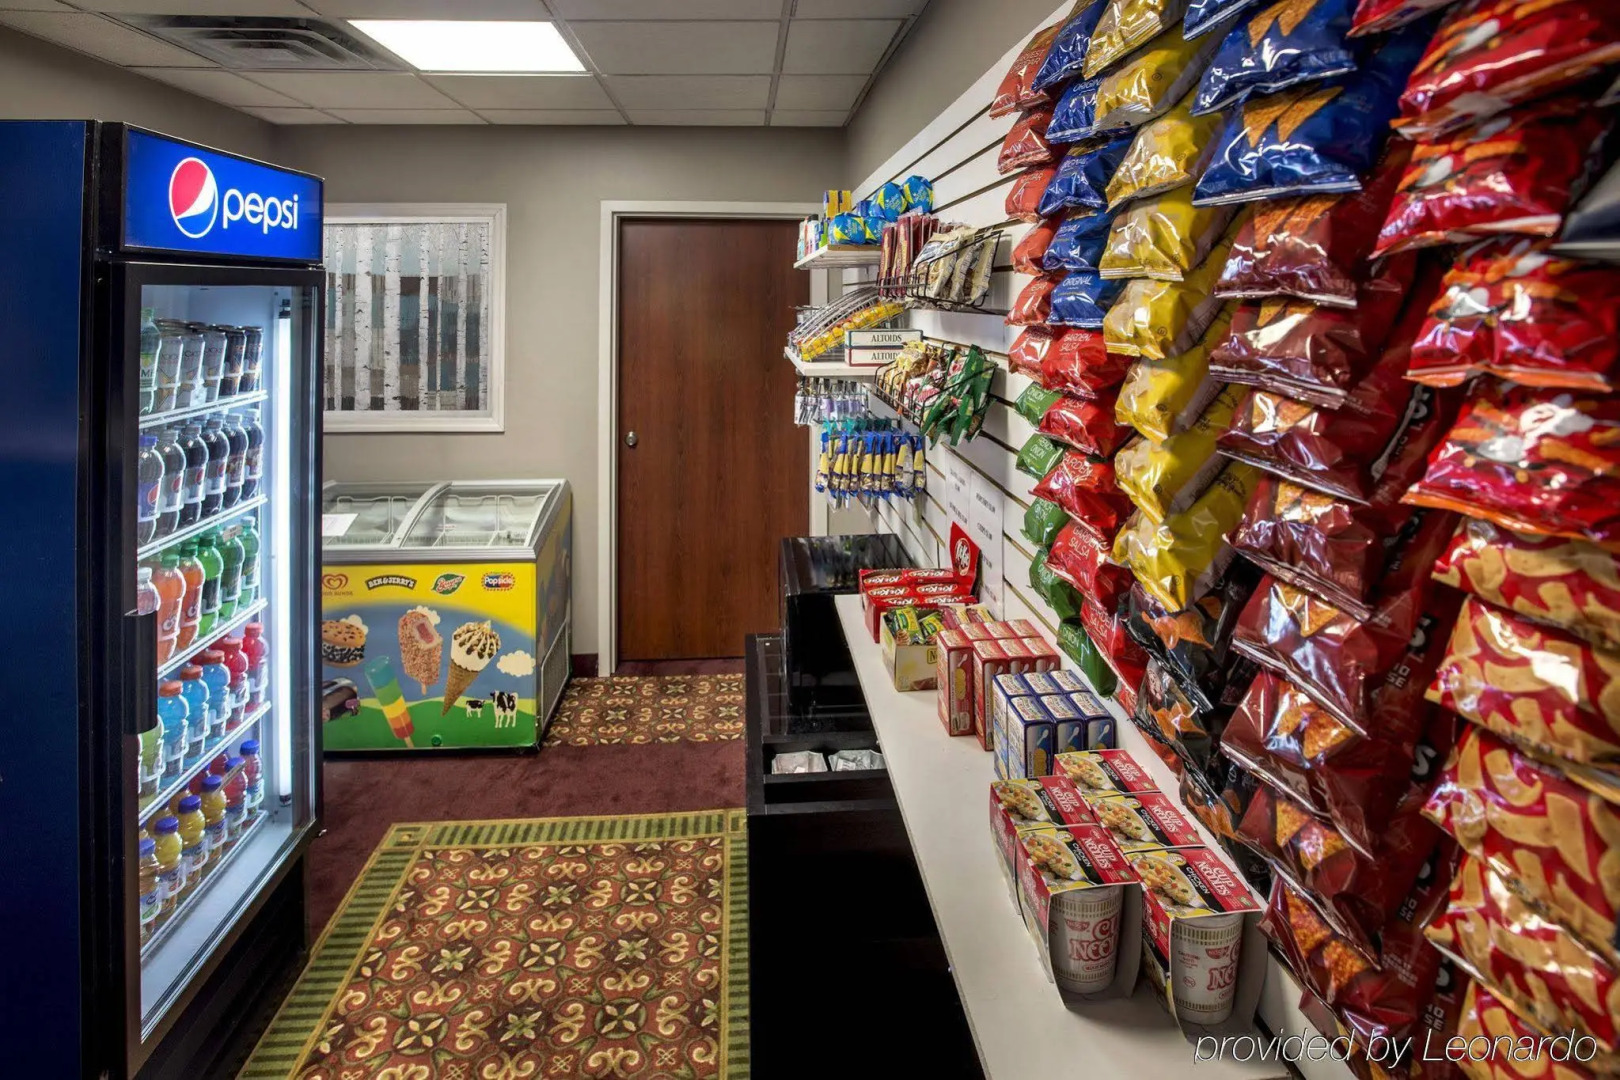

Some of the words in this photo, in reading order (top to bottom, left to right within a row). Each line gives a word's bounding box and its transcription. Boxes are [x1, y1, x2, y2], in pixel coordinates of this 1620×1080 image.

[222, 188, 299, 234] pepsi
[1062, 276, 1093, 287] ORIGINAL
[871, 334, 902, 342] ALTOIDS
[872, 352, 899, 360] ALTOID
[1068, 537, 1090, 559] SALSA
